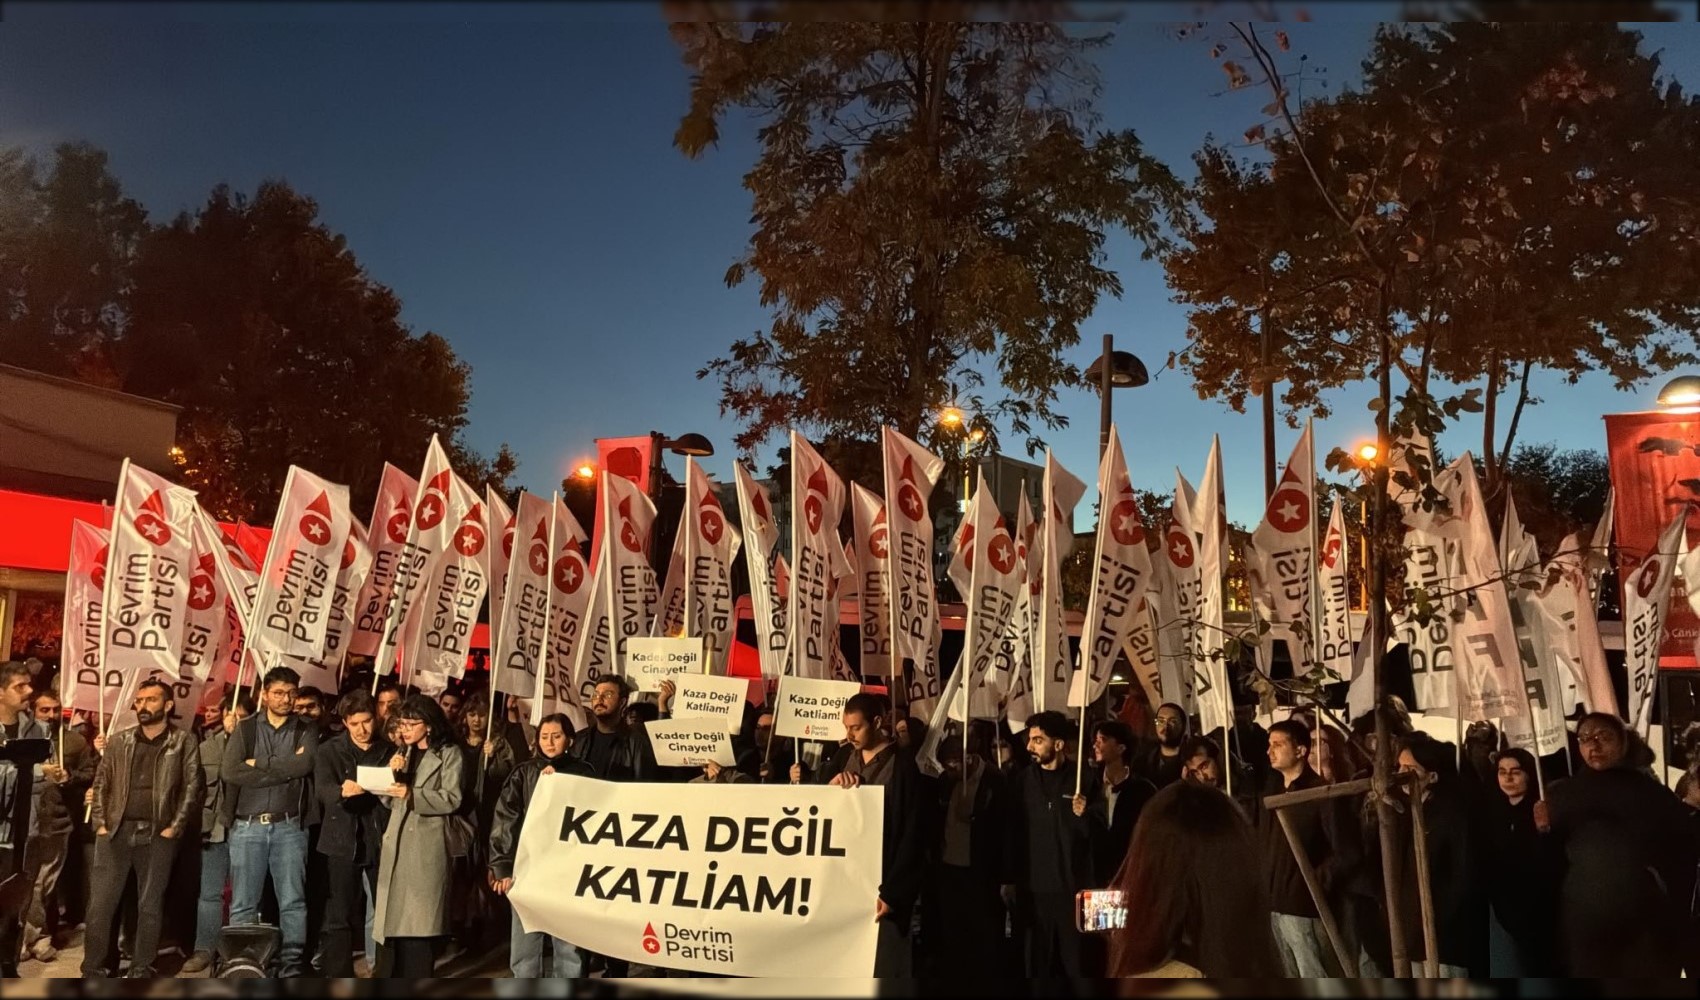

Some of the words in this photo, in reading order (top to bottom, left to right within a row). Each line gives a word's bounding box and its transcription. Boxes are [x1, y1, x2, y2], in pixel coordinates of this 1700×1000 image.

[112, 552, 149, 649] Devrim
[140, 553, 179, 652] Partisi
[267, 549, 308, 633] Devrim
[292, 554, 330, 643] Partisi
[358, 549, 392, 632] Devrim
[426, 563, 460, 649] Devrim
[442, 567, 482, 655] Partisi
[507, 582, 534, 671] Devrim
[637, 565, 658, 638] artisi
[762, 556, 787, 652] Devrim
[806, 550, 824, 661] Partisi
[863, 570, 881, 656] Devrim
[911, 537, 929, 641] Partisi
[1089, 560, 1141, 683] Partisi
[77, 600, 101, 687] Devrim
[554, 607, 579, 708] Partisi
[580, 615, 609, 699] Devrim
[642, 665, 687, 676] Cinayet!
[668, 652, 697, 664] Değil
[655, 732, 691, 740] Kader
[694, 731, 725, 743] Değil
[683, 689, 707, 699] Kaza
[709, 691, 738, 704] Değil
[686, 701, 729, 714] Katliam!
[789, 693, 818, 706] Kaza
[794, 708, 840, 720] Katliam!
[668, 743, 717, 754] Cinayet!
[559, 806, 690, 852] KAZA
[705, 805, 846, 857] DEĞİL
[575, 860, 812, 917] KATLİAM!
[664, 922, 733, 944] Devrim
[666, 941, 734, 963] Partisi
